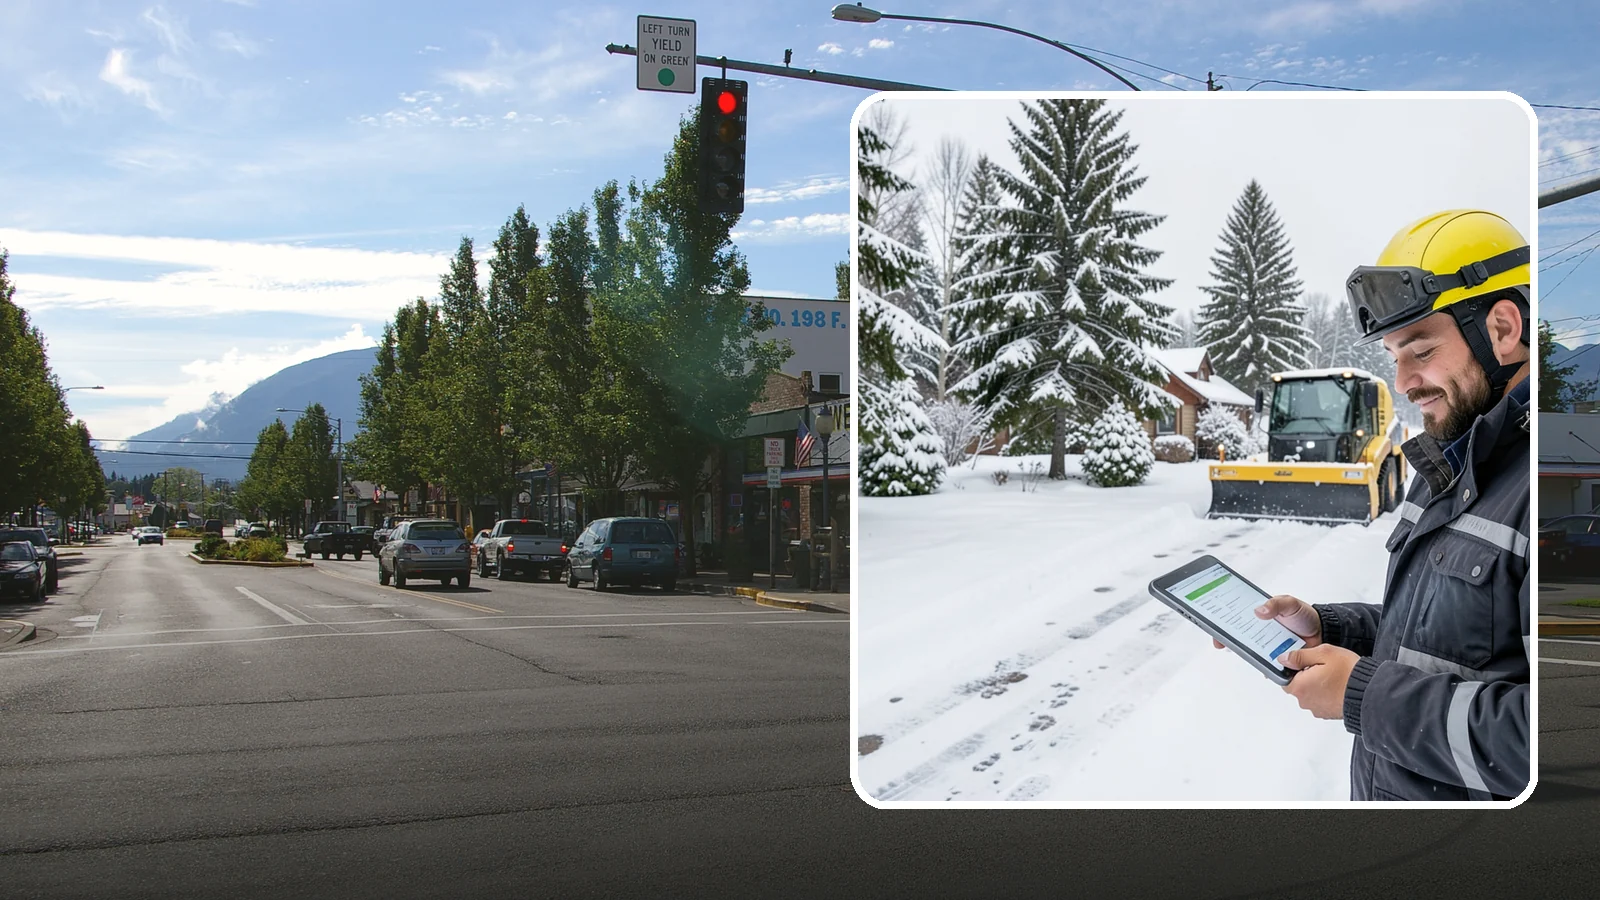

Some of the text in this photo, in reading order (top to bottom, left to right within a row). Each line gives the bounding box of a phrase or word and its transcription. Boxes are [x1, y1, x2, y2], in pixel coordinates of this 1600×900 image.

[643, 24, 690, 36] LEFT TURN
[652, 38, 682, 51] YIELD
[644, 53, 689, 66] ON GREEN
[791, 309, 826, 328] 198
[831, 311, 846, 329] F.
